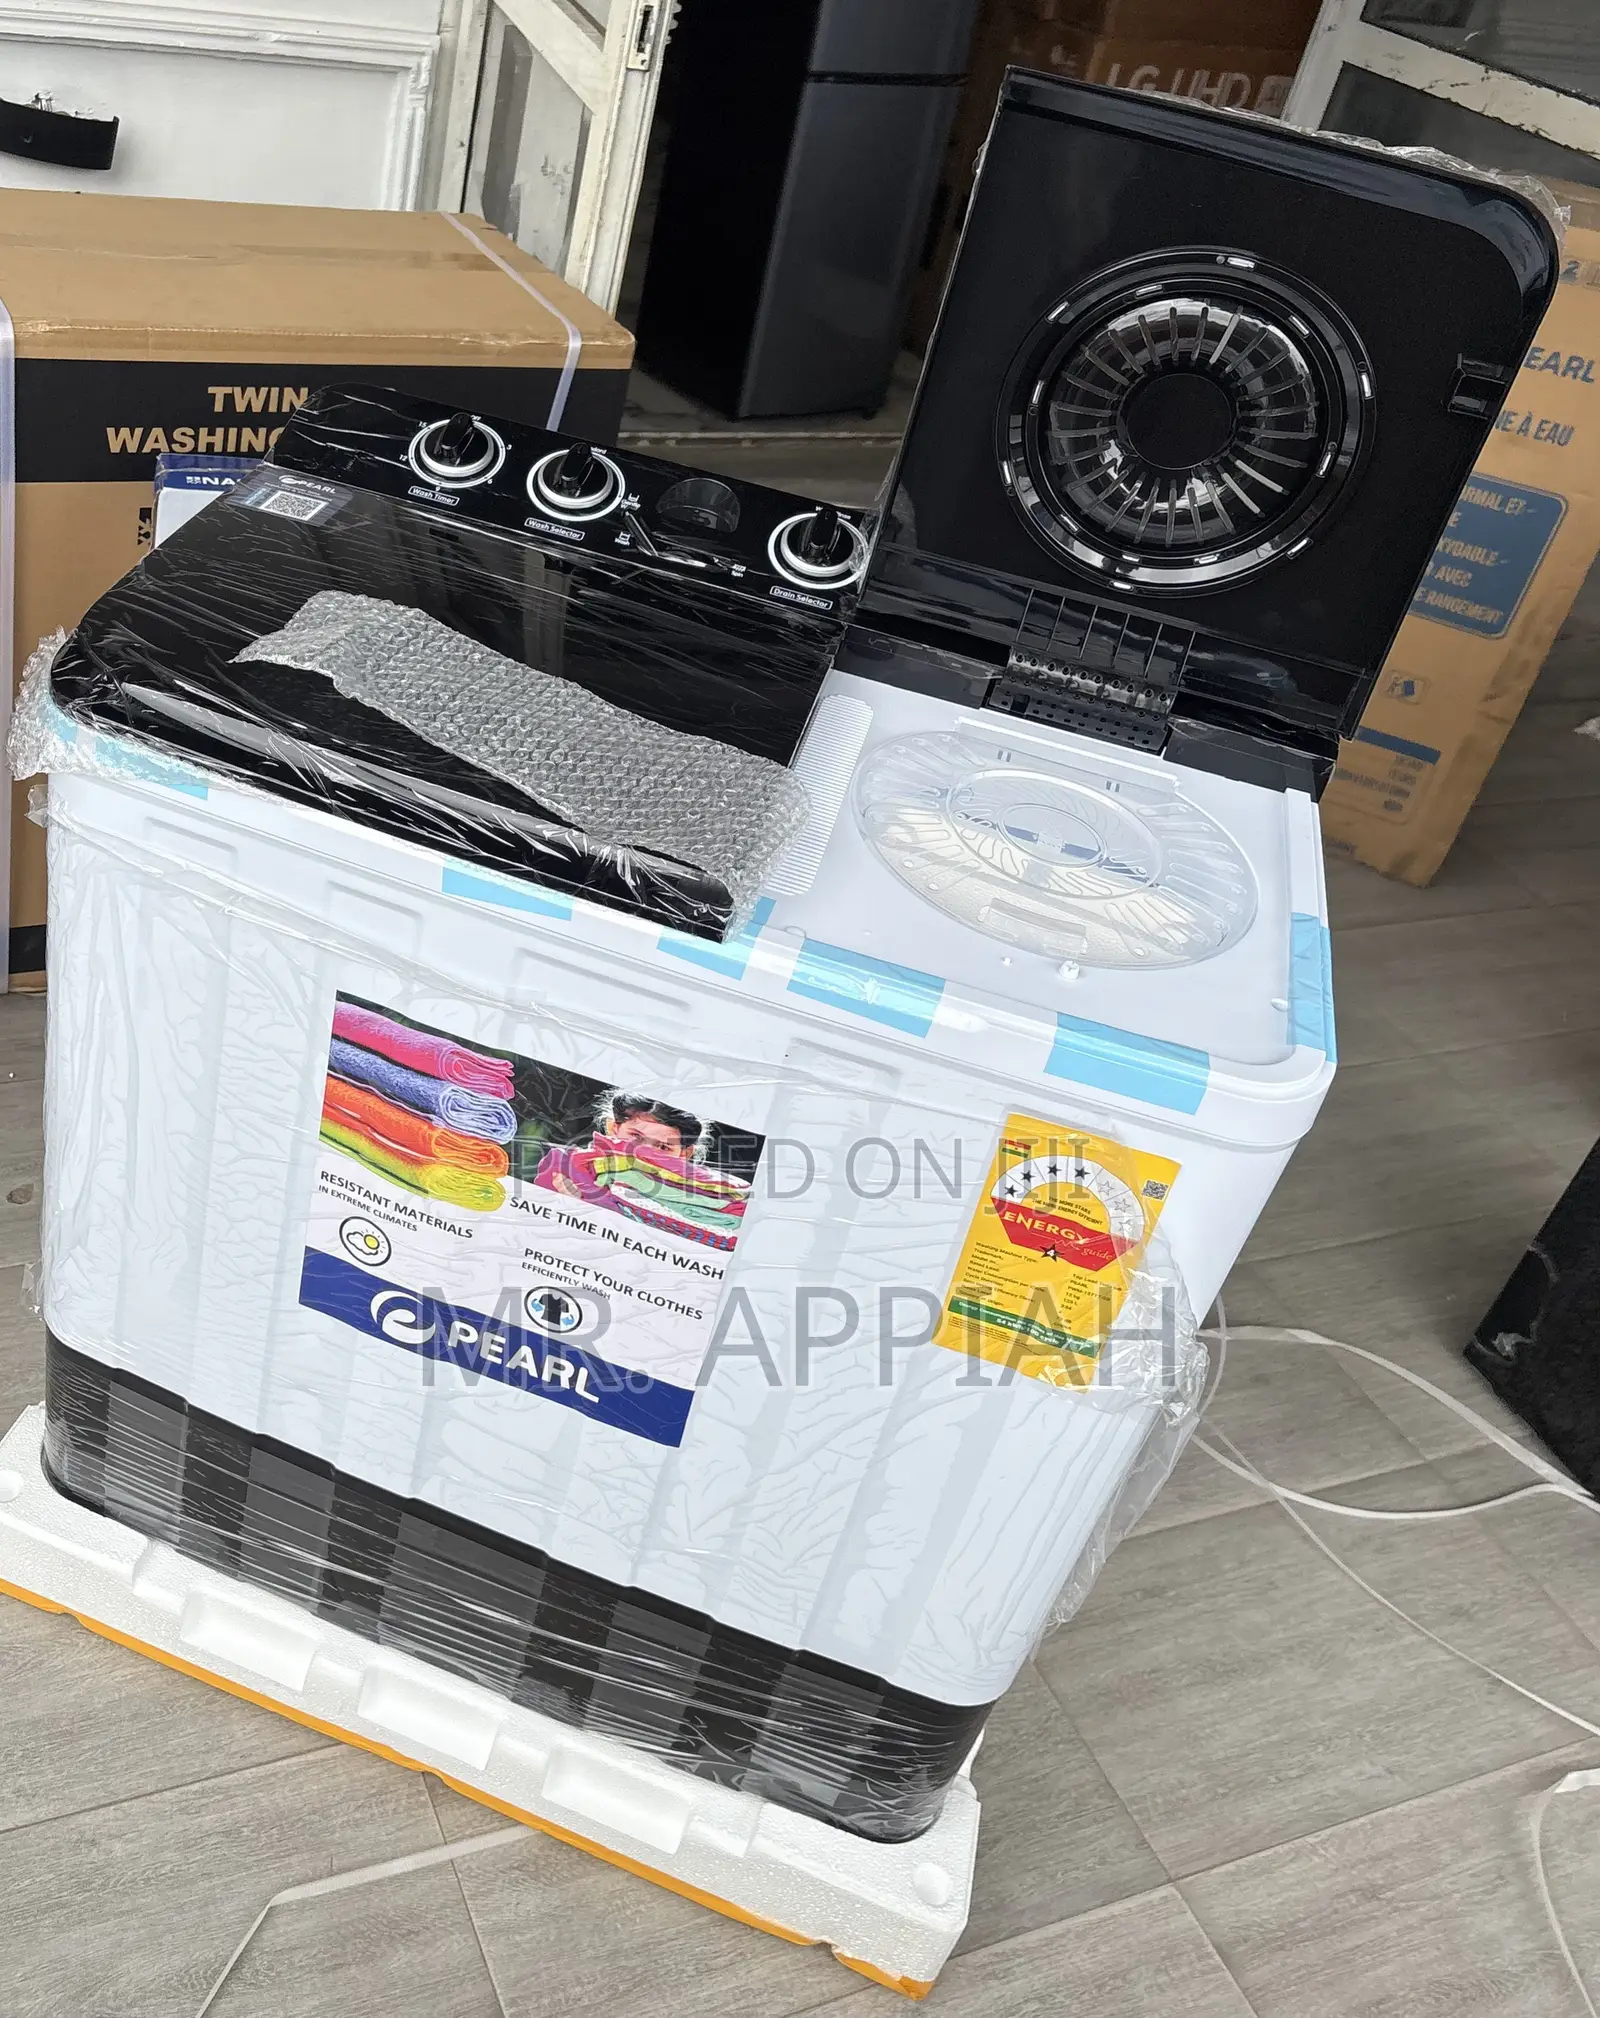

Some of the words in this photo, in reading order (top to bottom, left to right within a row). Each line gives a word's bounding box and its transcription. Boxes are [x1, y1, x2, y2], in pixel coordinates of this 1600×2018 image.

[1523, 346, 1596, 384] EARL
[207, 386, 309, 413] TWIN
[202, 476, 240, 486] NA
[412, 487, 433, 498] Wash
[434, 493, 456, 504] Timer
[1461, 485, 1504, 511] RMAL
[528, 519, 550, 531] Wash
[551, 526, 582, 539] Selector
[773, 588, 796, 599] Drain
[797, 594, 829, 608] Selector
[318, 1184, 328, 1194] IN
[329, 1188, 372, 1213] EXTREME
[372, 1207, 419, 1233] CLIMATES
[319, 1170, 391, 1211] RESISTANT
[394, 1203, 474, 1240] MATERIALS
[509, 1196, 552, 1224] SAVE
[556, 1213, 597, 1238] TIME
[600, 1227, 620, 1246] IN
[621, 1236, 668, 1264] EACH
[672, 1251, 726, 1281] WASH
[1003, 1211, 1090, 1245] ENERGY
[1046, 1249, 1055, 1257] 4
[1081, 1246, 1113, 1260] guide
[521, 1261, 581, 1289] EFFICIENTLY
[581, 1282, 612, 1301] WASH
[524, 1247, 590, 1278] PROTECT
[592, 1270, 635, 1297] YOUR
[637, 1286, 704, 1322] CLOTHES
[447, 1320, 601, 1405] PEARL
